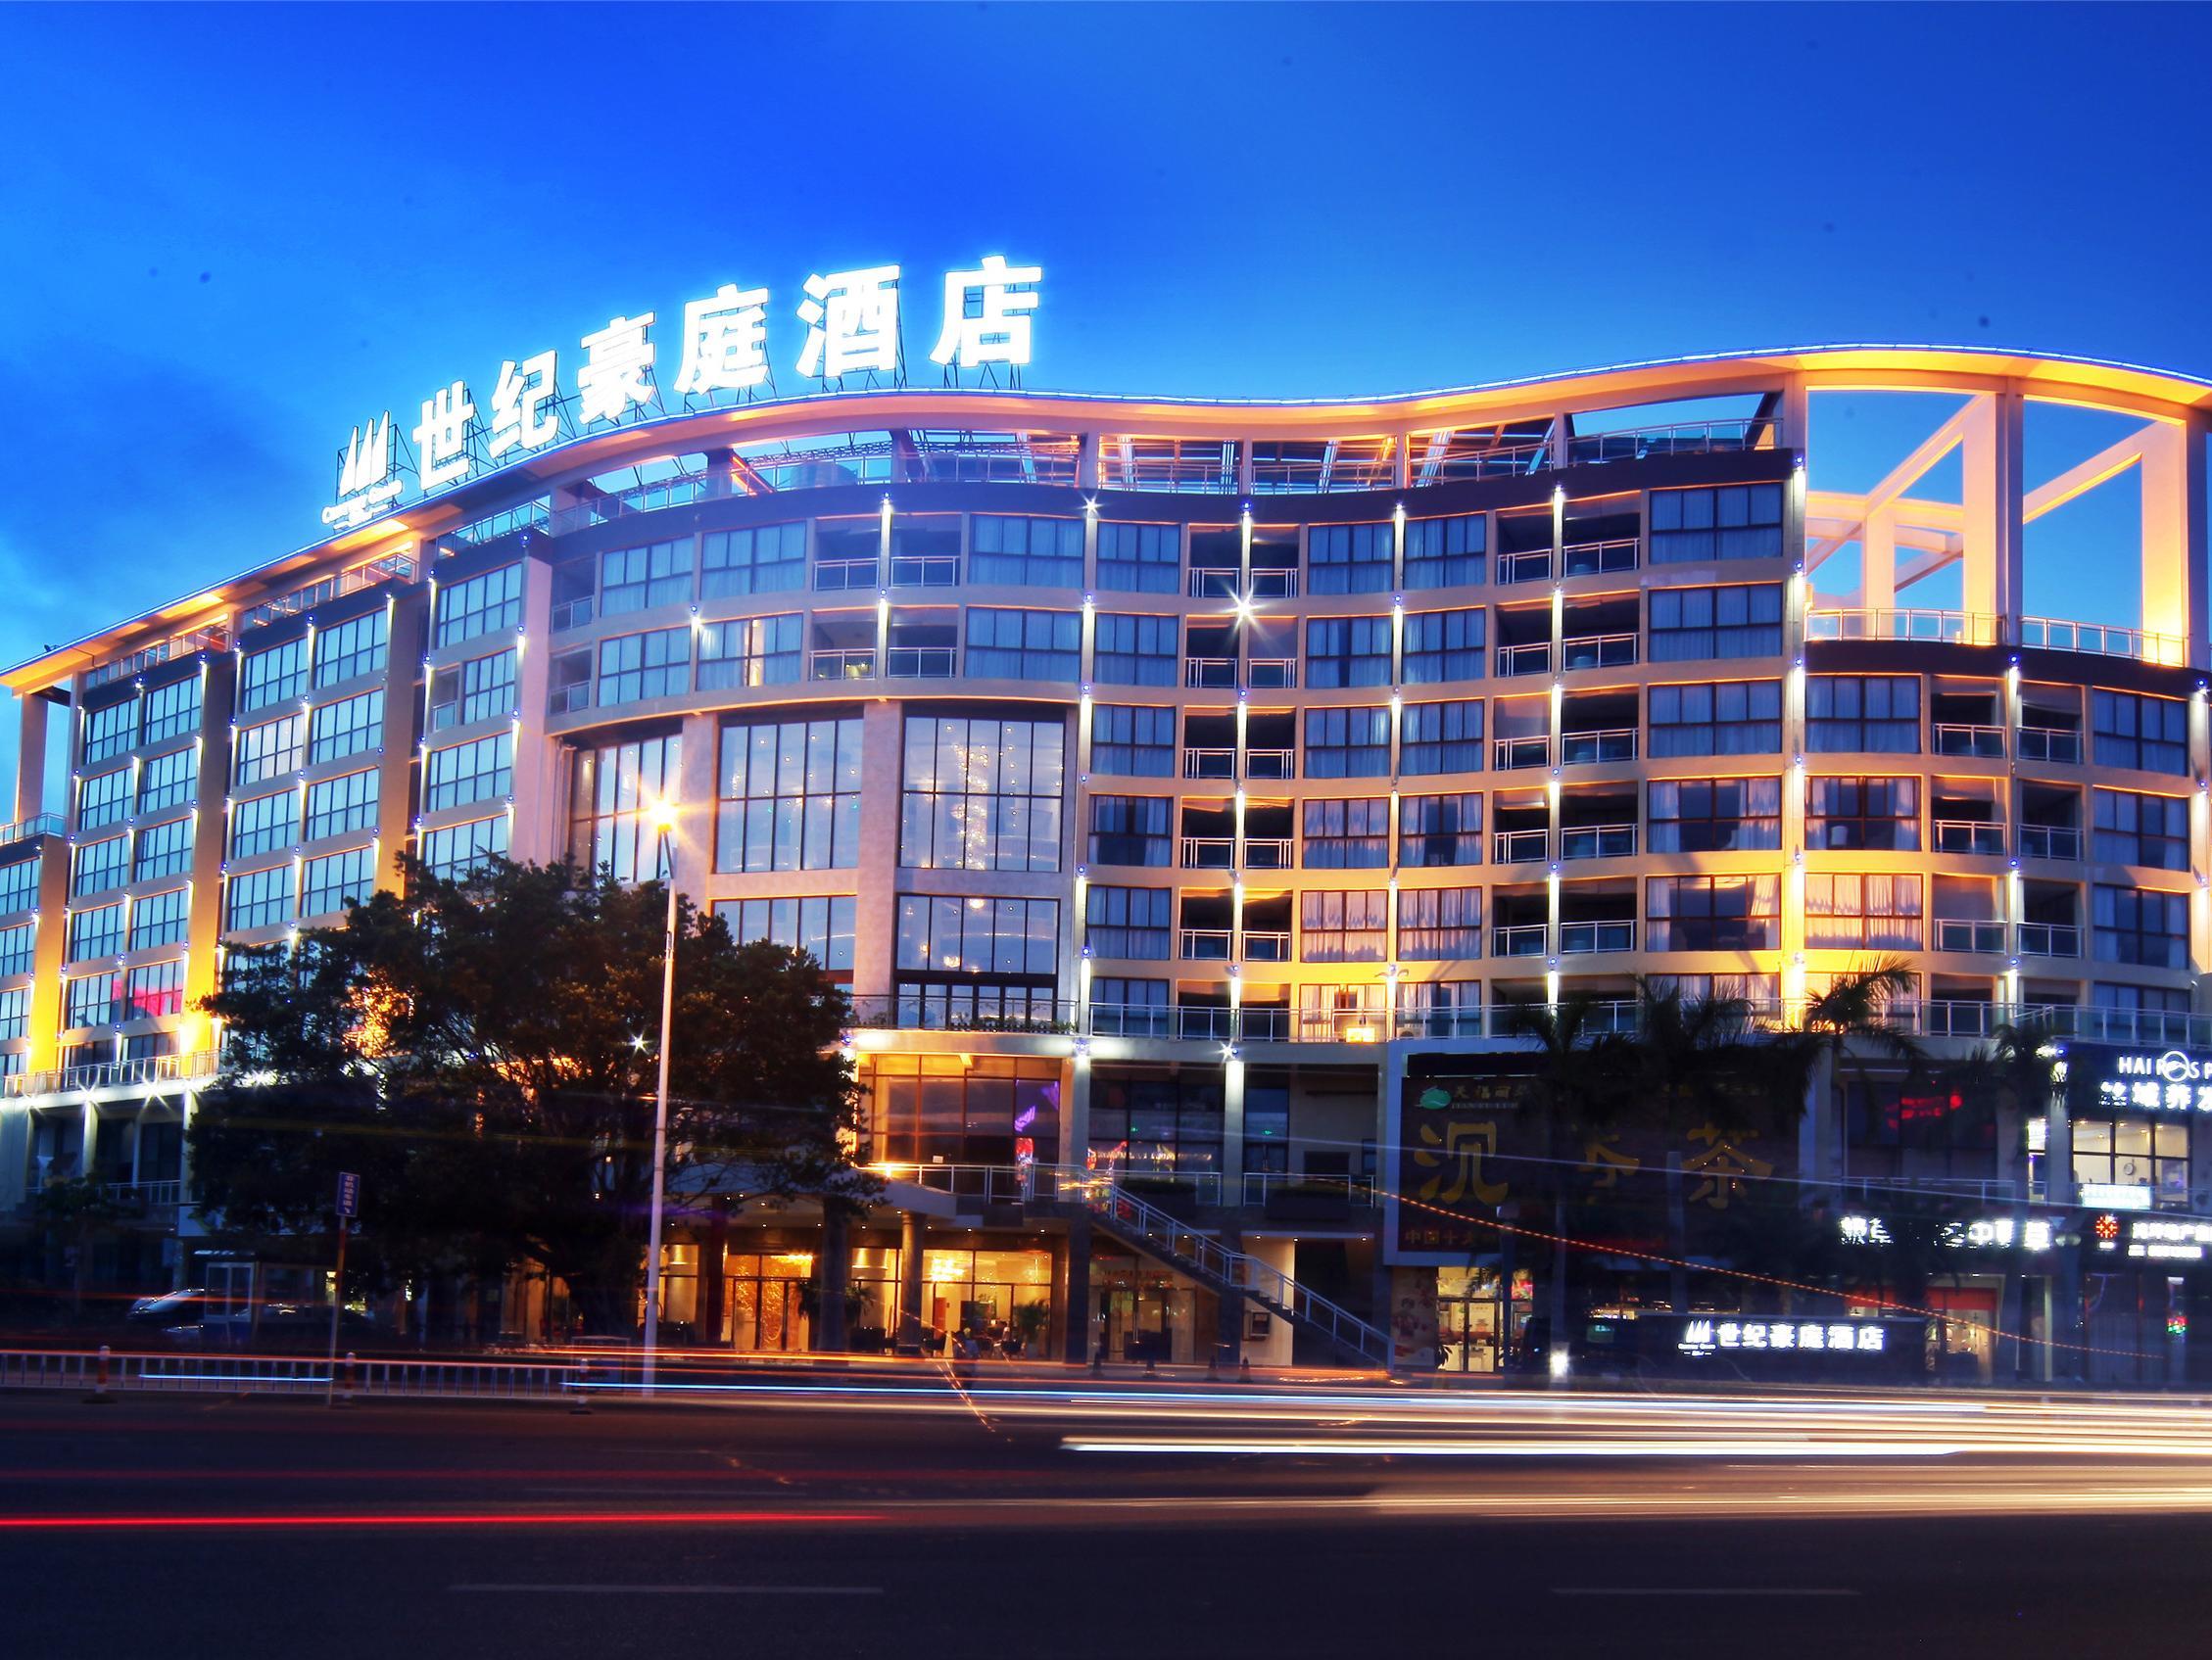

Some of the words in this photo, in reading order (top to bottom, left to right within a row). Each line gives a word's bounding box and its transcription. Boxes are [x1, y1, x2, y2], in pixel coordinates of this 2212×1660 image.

[412, 255, 1042, 490] 世纪豪庭酒店
[1716, 1323, 1885, 1351] 世纪豪庭酒店
